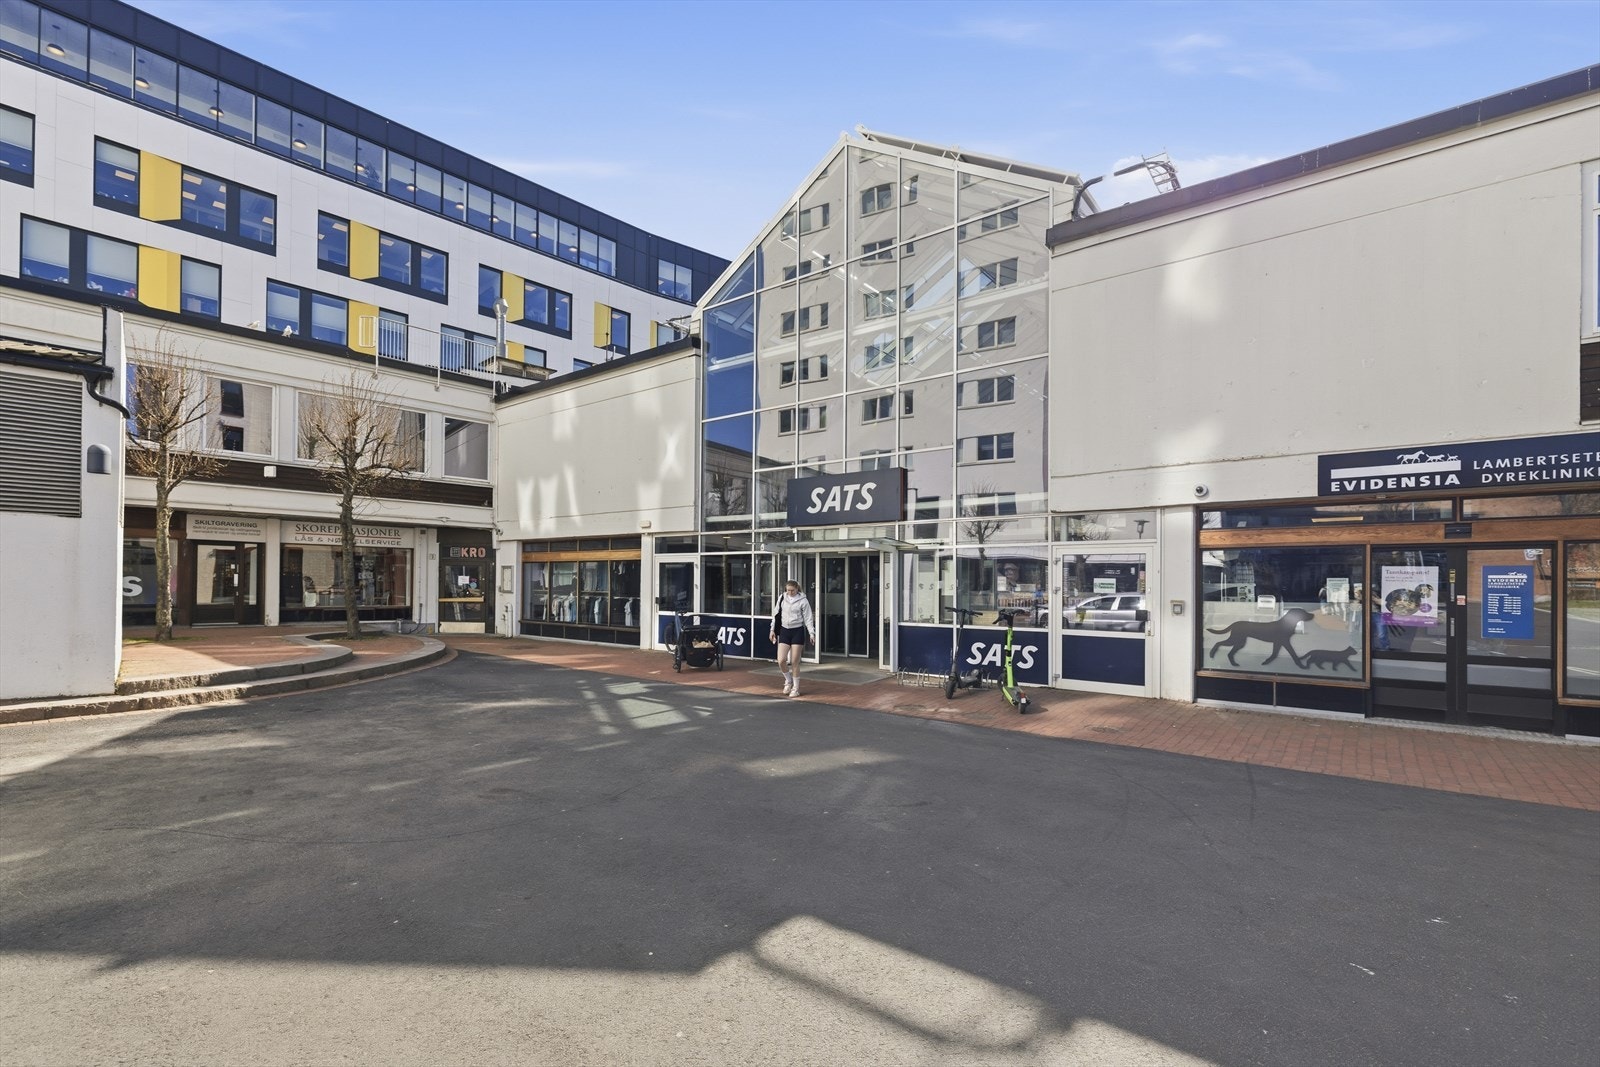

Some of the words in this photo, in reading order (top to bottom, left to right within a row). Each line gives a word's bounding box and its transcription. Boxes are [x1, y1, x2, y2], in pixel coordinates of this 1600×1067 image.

[1481, 466, 1600, 483] DYREKLINIK
[1330, 473, 1460, 492] EVIDENSIA
[806, 482, 877, 514] SATS
[194, 519, 258, 528] SKILTGRAVERING
[295, 523, 401, 537] SKOREPASJONER
[327, 537, 402, 546] NØELSERVICE
[461, 547, 486, 558] KRO
[716, 626, 746, 646] ATS
